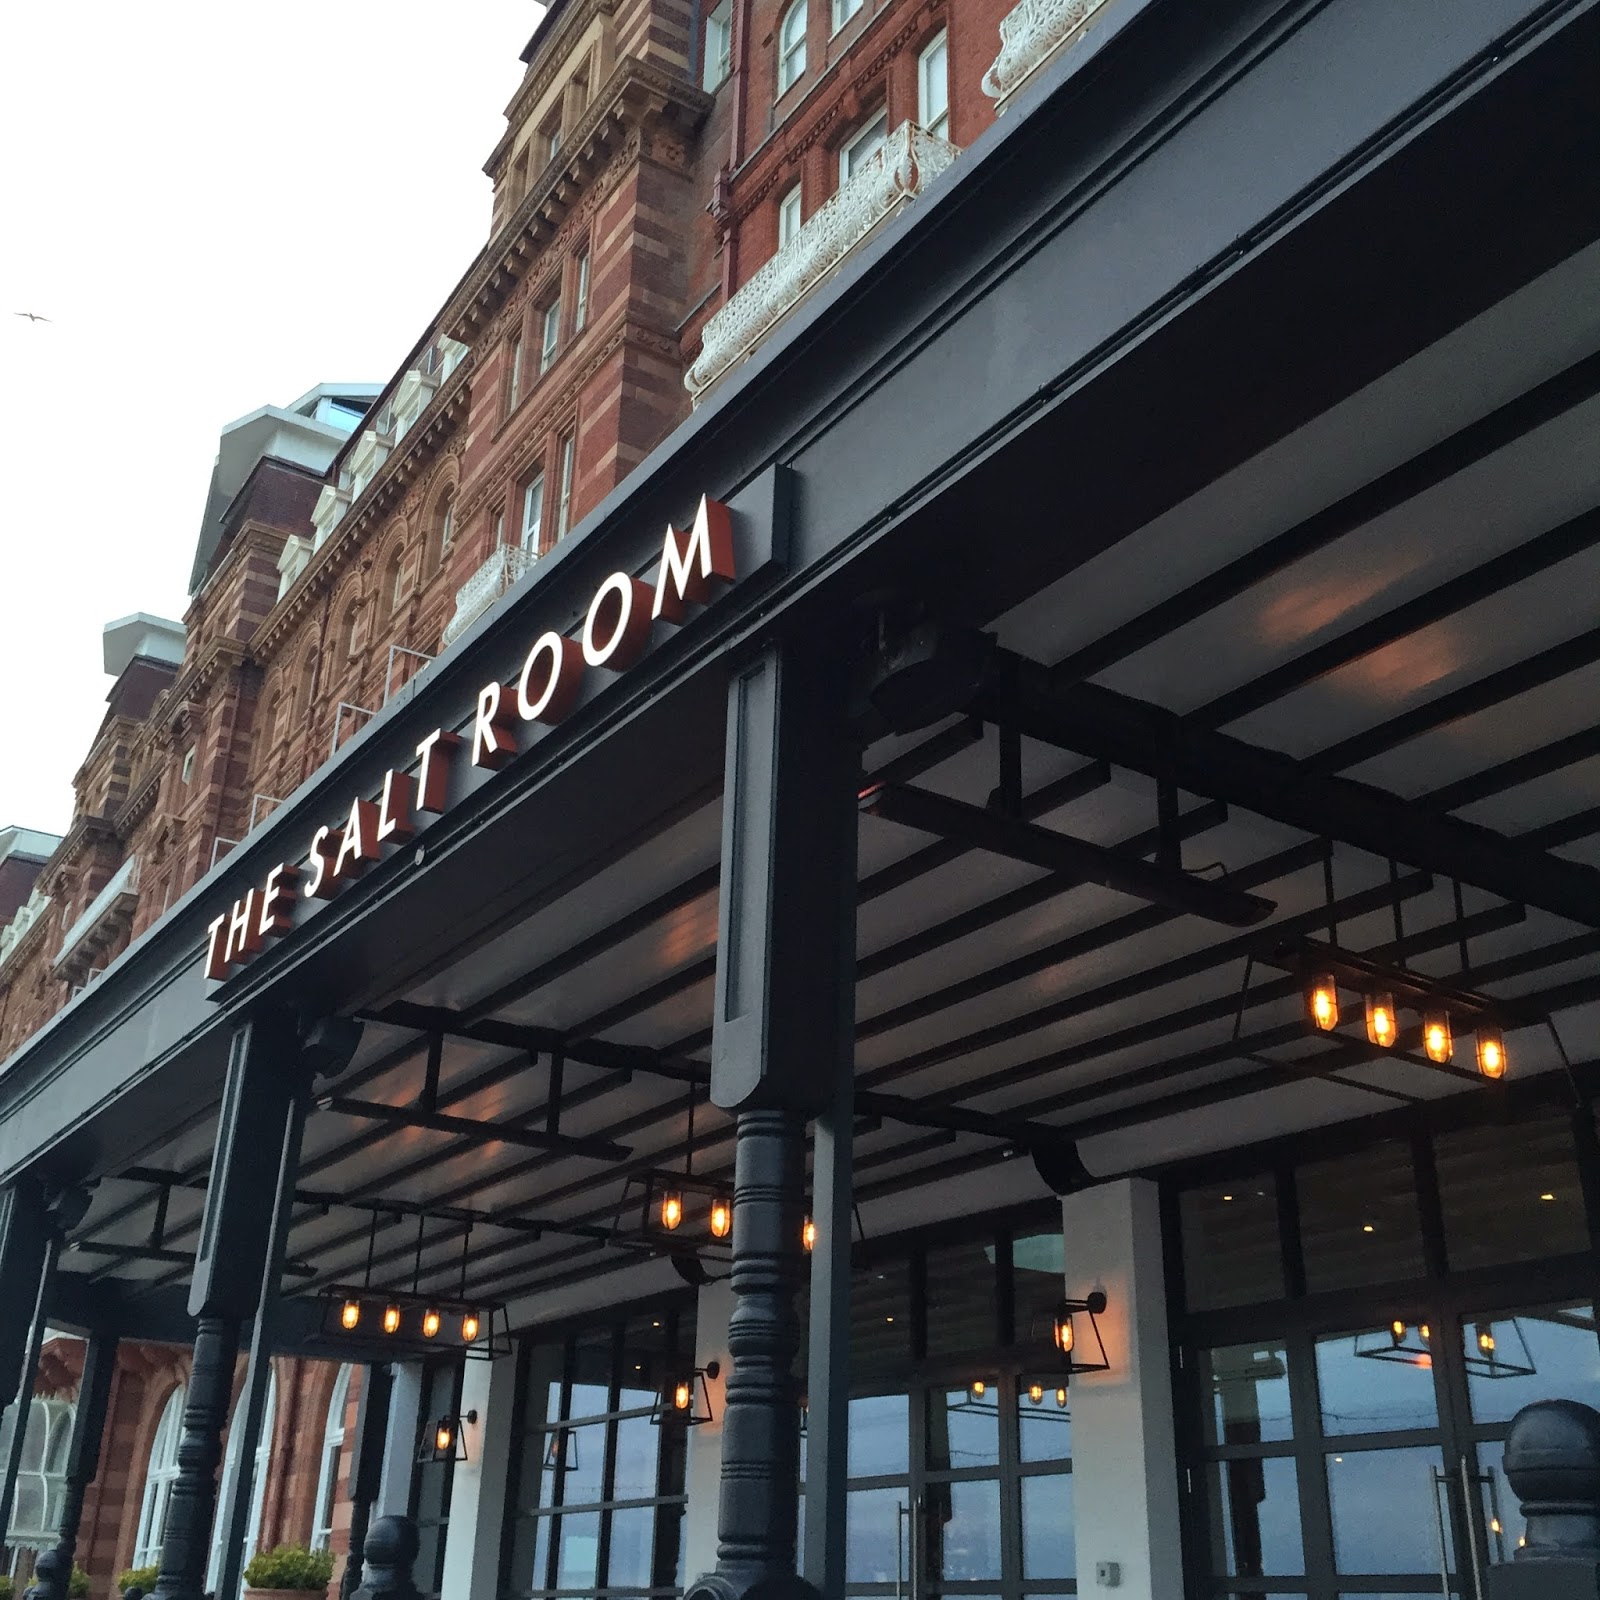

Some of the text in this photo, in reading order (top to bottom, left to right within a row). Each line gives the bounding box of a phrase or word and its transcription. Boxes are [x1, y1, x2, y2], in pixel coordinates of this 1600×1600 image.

[204, 492, 713, 980] THE SALT ROOM
